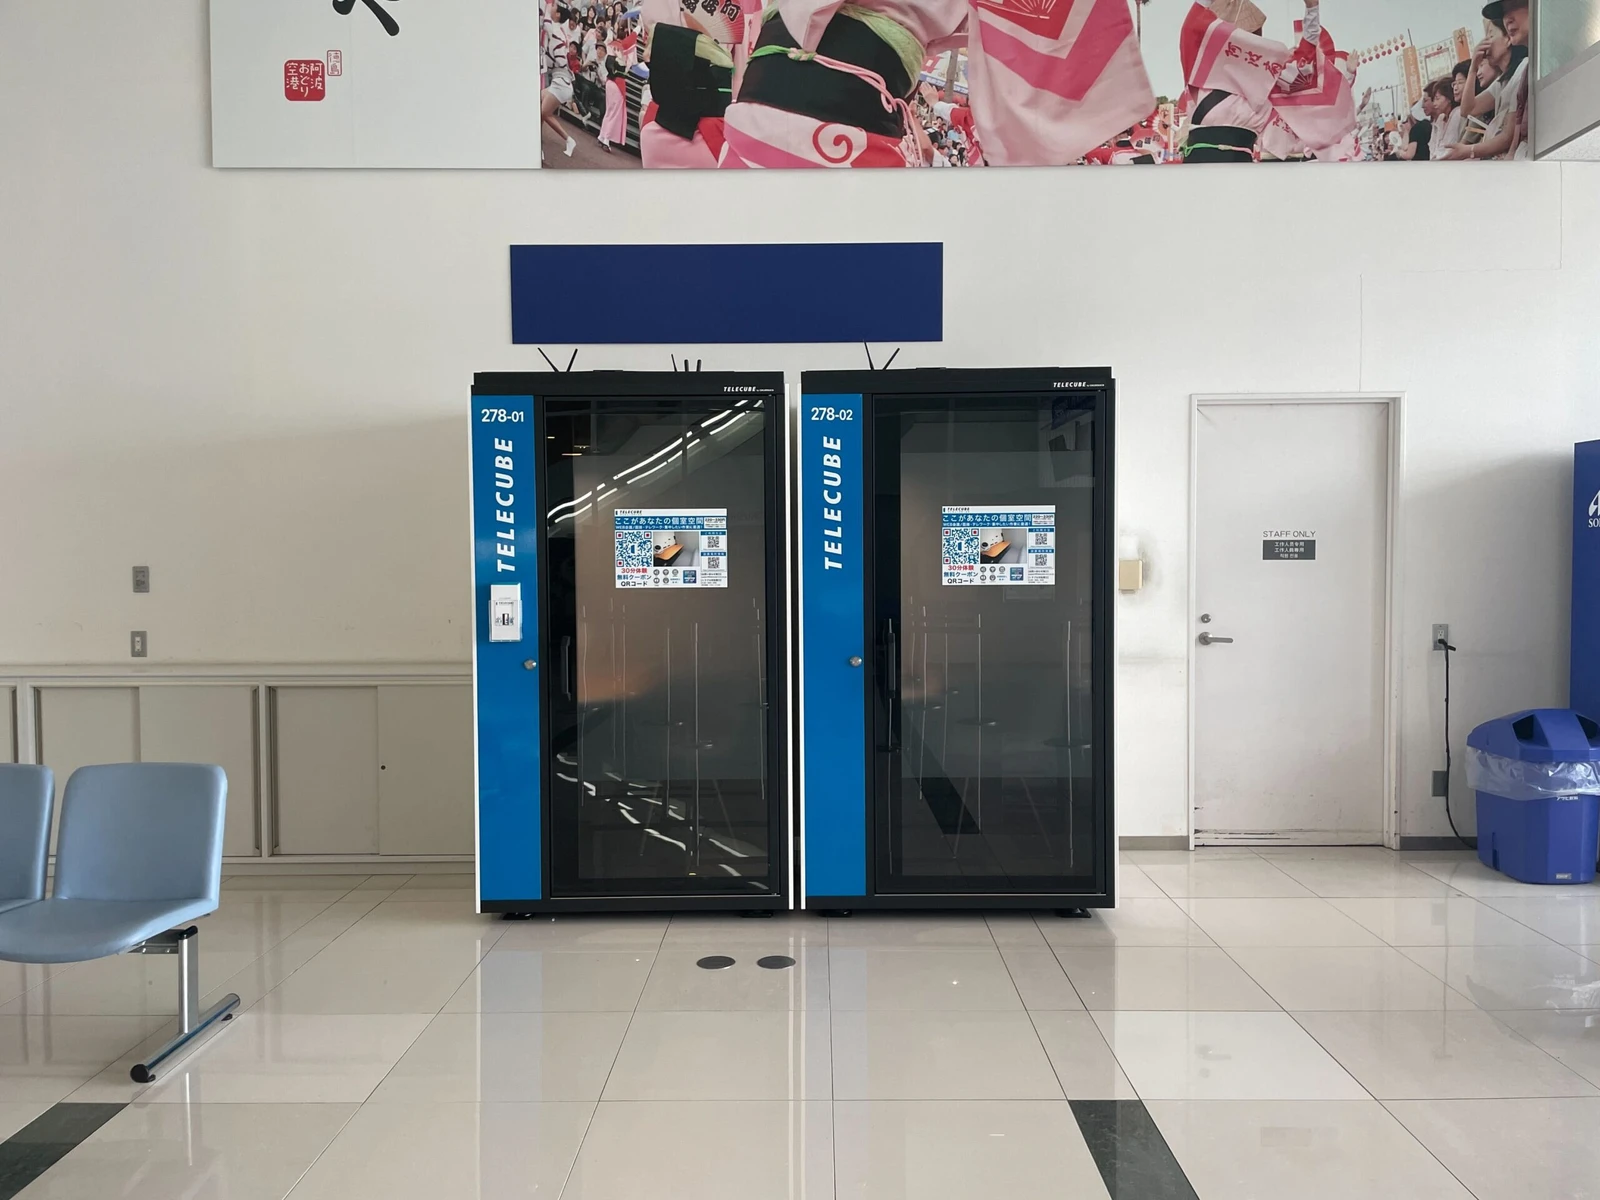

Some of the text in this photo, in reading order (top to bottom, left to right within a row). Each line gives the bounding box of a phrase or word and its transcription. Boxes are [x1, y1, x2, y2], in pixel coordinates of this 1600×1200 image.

[286, 62, 299, 90] 空港
[299, 63, 310, 97] おどり
[309, 62, 323, 90] 阿波
[481, 409, 525, 423] 278-01
[811, 407, 853, 421] 278-02
[494, 437, 516, 573] TELECUBE
[823, 436, 843, 570] TELECUBE
[615, 517, 704, 525] ここがあなたの個室空間
[942, 514, 1032, 522] ここがあなたの個室空間
[1588, 518, 1600, 528] SO
